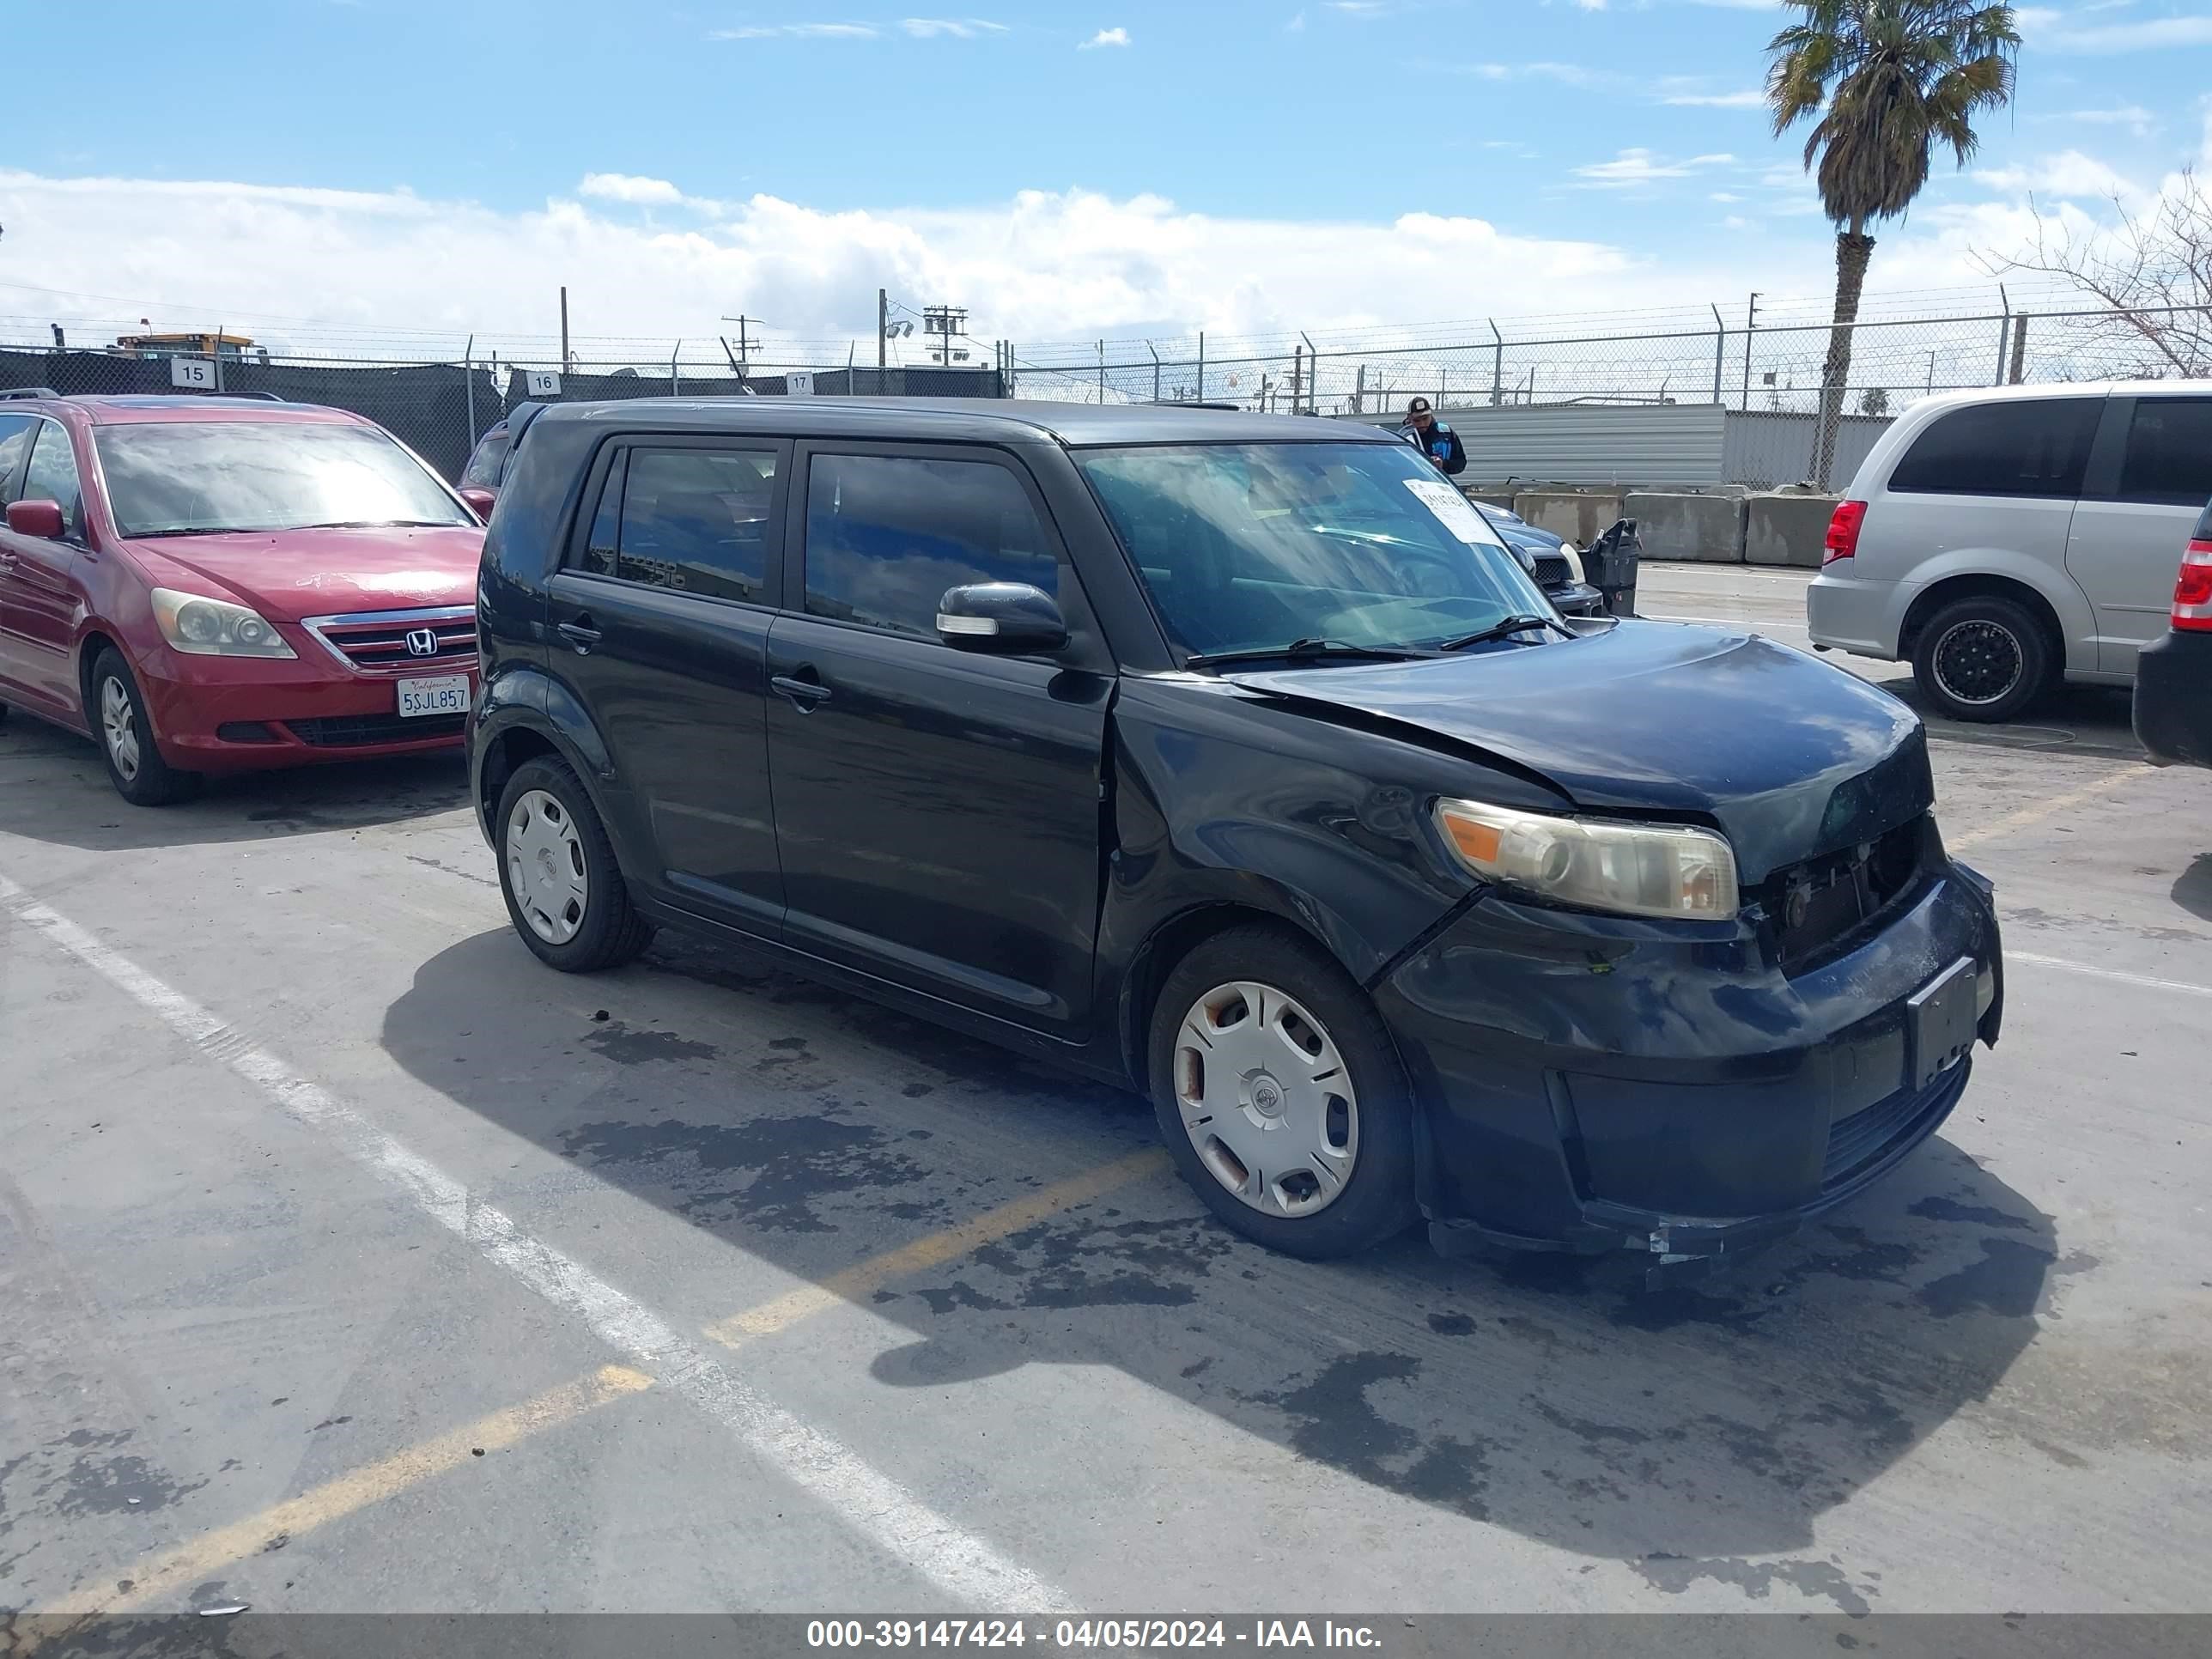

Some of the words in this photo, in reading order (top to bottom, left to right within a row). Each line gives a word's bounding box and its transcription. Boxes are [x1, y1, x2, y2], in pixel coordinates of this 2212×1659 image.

[182, 366, 204, 381] 15
[535, 376, 552, 389] 16
[793, 377, 806, 389] 17
[404, 690, 465, 711] 5SJL857
